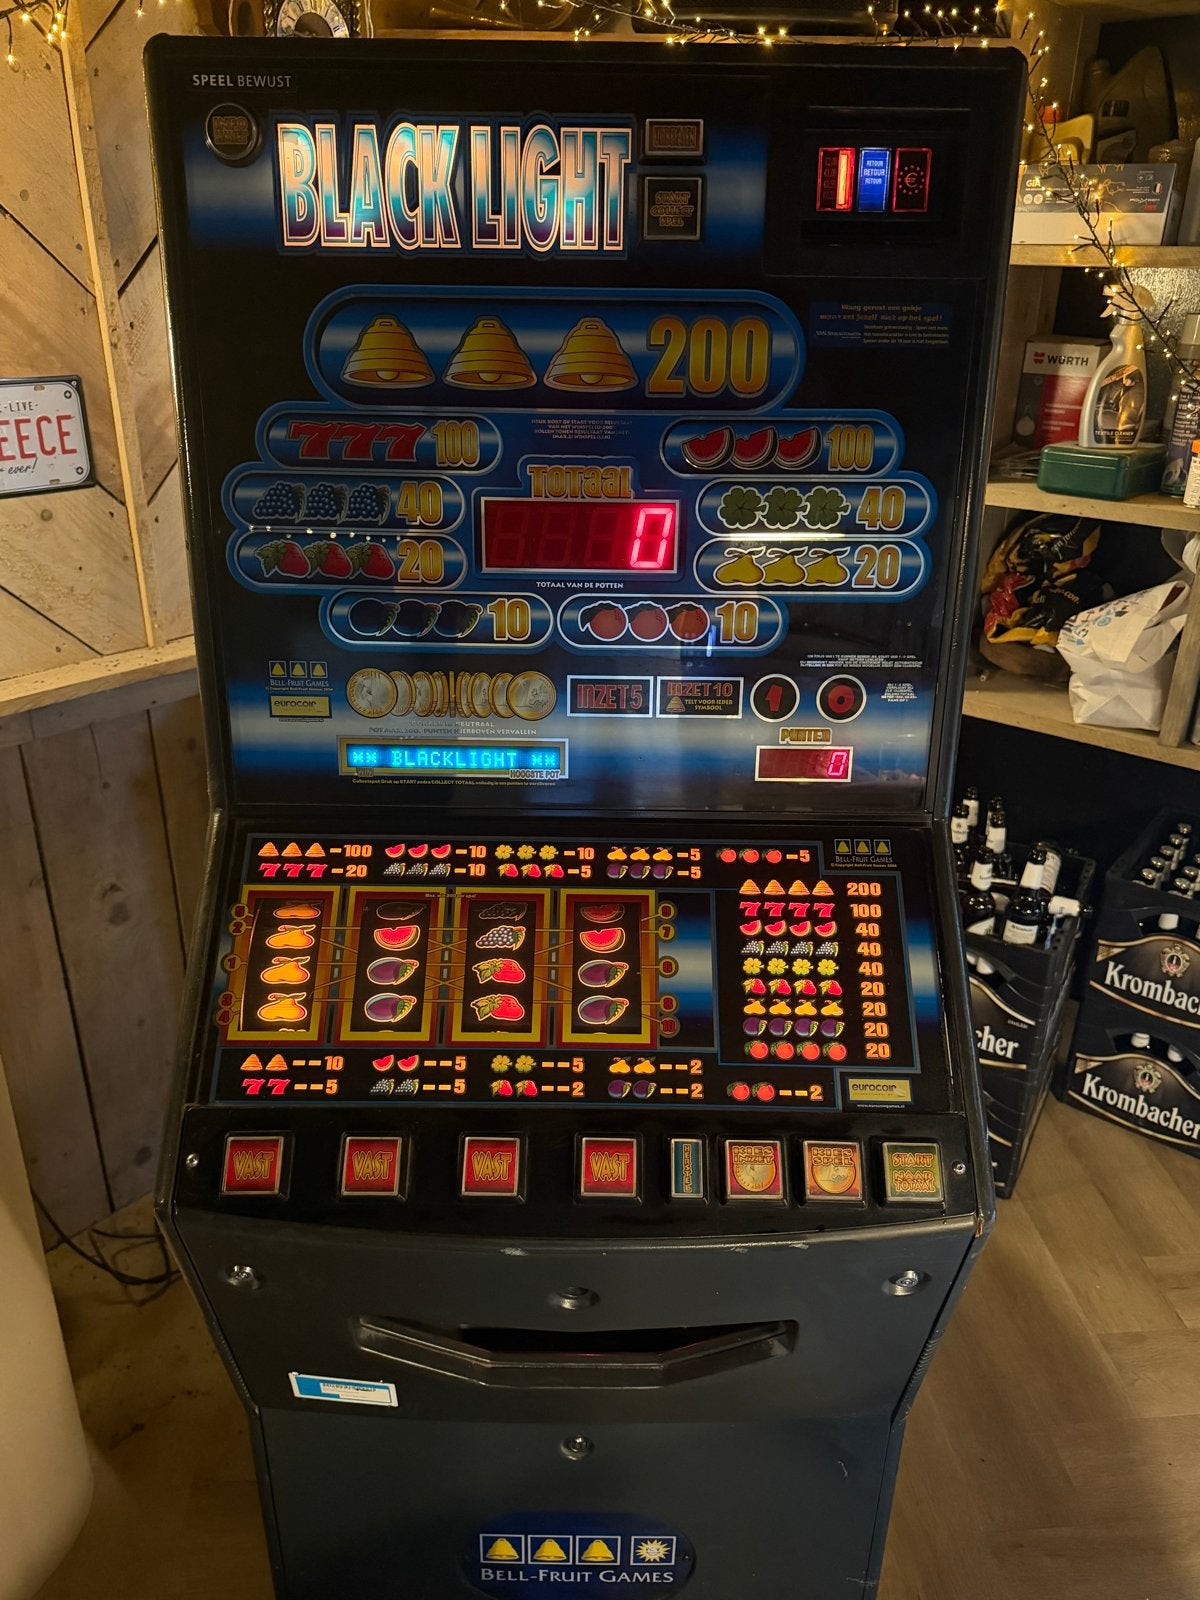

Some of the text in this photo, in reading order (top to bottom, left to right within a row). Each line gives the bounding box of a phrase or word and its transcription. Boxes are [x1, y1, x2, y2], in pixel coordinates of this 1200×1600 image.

[191, 73, 292, 88] SPEEL BEWUST
[276, 121, 633, 253] BLACK LIGHT
[654, 191, 691, 205] START
[649, 205, 695, 217] COLLECT
[658, 215, 685, 227] SPEL
[647, 316, 771, 397] 200
[1047, 353, 1089, 367] WÜRTH
[431, 420, 480, 467] 100
[825, 424, 874, 471] 100
[396, 480, 443, 526] 40
[856, 485, 905, 531] 40
[629, 506, 674, 569] 0
[397, 539, 445, 584] 20
[852, 544, 903, 588] 20
[535, 580, 624, 589] TOTAAL VAN DE POTTEN
[487, 598, 532, 641] 10
[715, 600, 765, 643] 10
[305, 679, 329, 687] GAMES
[666, 681, 733, 697] INZET 10
[576, 683, 643, 710] INZET 5
[685, 698, 698, 706] TELT
[699, 698, 714, 706] VOOR
[779, 727, 832, 744] PUNTEN
[391, 750, 518, 767] BLACKLIGHT
[826, 751, 848, 776] 0
[509, 769, 544, 780] HOOGSTE
[545, 770, 560, 780] POT
[835, 855, 893, 864] BELL-FRUIT GAMES
[847, 882, 882, 897] 200
[850, 904, 882, 918] 100
[661, 926, 672, 938] 7
[855, 923, 880, 937] 40
[857, 942, 882, 956] 40
[858, 961, 883, 976] 40
[860, 981, 885, 997] 20
[1104, 960, 1200, 1016] Krombac
[862, 1002, 887, 1017] 20
[864, 1022, 889, 1038] 20
[866, 1043, 891, 1059] 20
[1082, 1072, 1200, 1140] Krombacher
[732, 1145, 774, 1156] KIES
[811, 1146, 854, 1157] KIES
[232, 1150, 275, 1181] VAST
[351, 1150, 393, 1181] VAST
[471, 1151, 513, 1182] VAST
[589, 1151, 630, 1182] VAST
[732, 1154, 775, 1165] INZET
[812, 1156, 855, 1167] SPEL
[892, 1152, 933, 1167] START
[682, 1143, 693, 1193] HERSTEL
[892, 1169, 934, 1182] NAAR
[893, 1180, 936, 1192] TOTAAL
[480, 1568, 674, 1583] BELL-FRUIT GAMES
